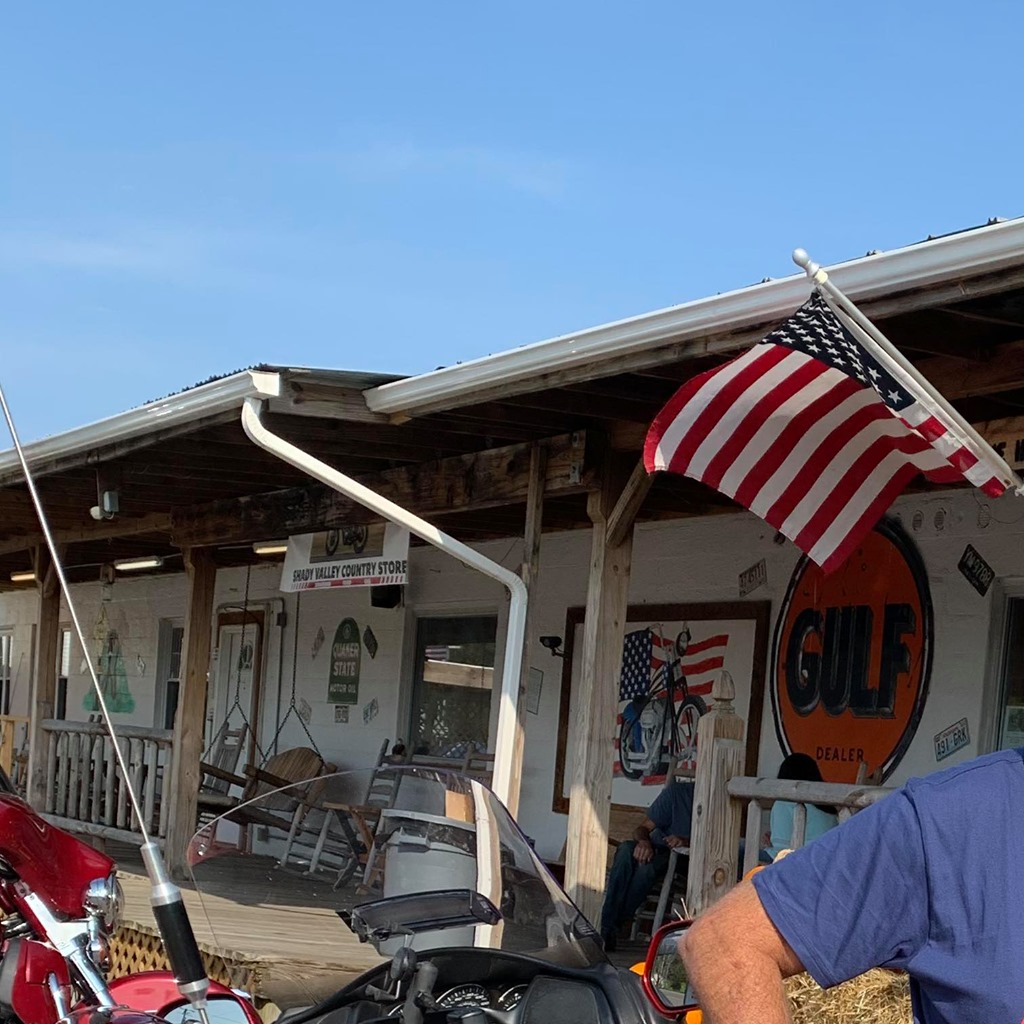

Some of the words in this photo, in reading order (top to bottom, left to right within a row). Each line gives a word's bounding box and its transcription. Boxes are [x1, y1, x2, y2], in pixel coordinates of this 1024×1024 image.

[293, 568, 314, 583] SHADY
[315, 564, 341, 580] VALLEY
[341, 561, 377, 578] COUNTRY
[378, 559, 408, 575] STORE
[333, 662, 357, 677] STATE
[786, 603, 916, 719] GULF
[816, 746, 865, 762] DEALER
